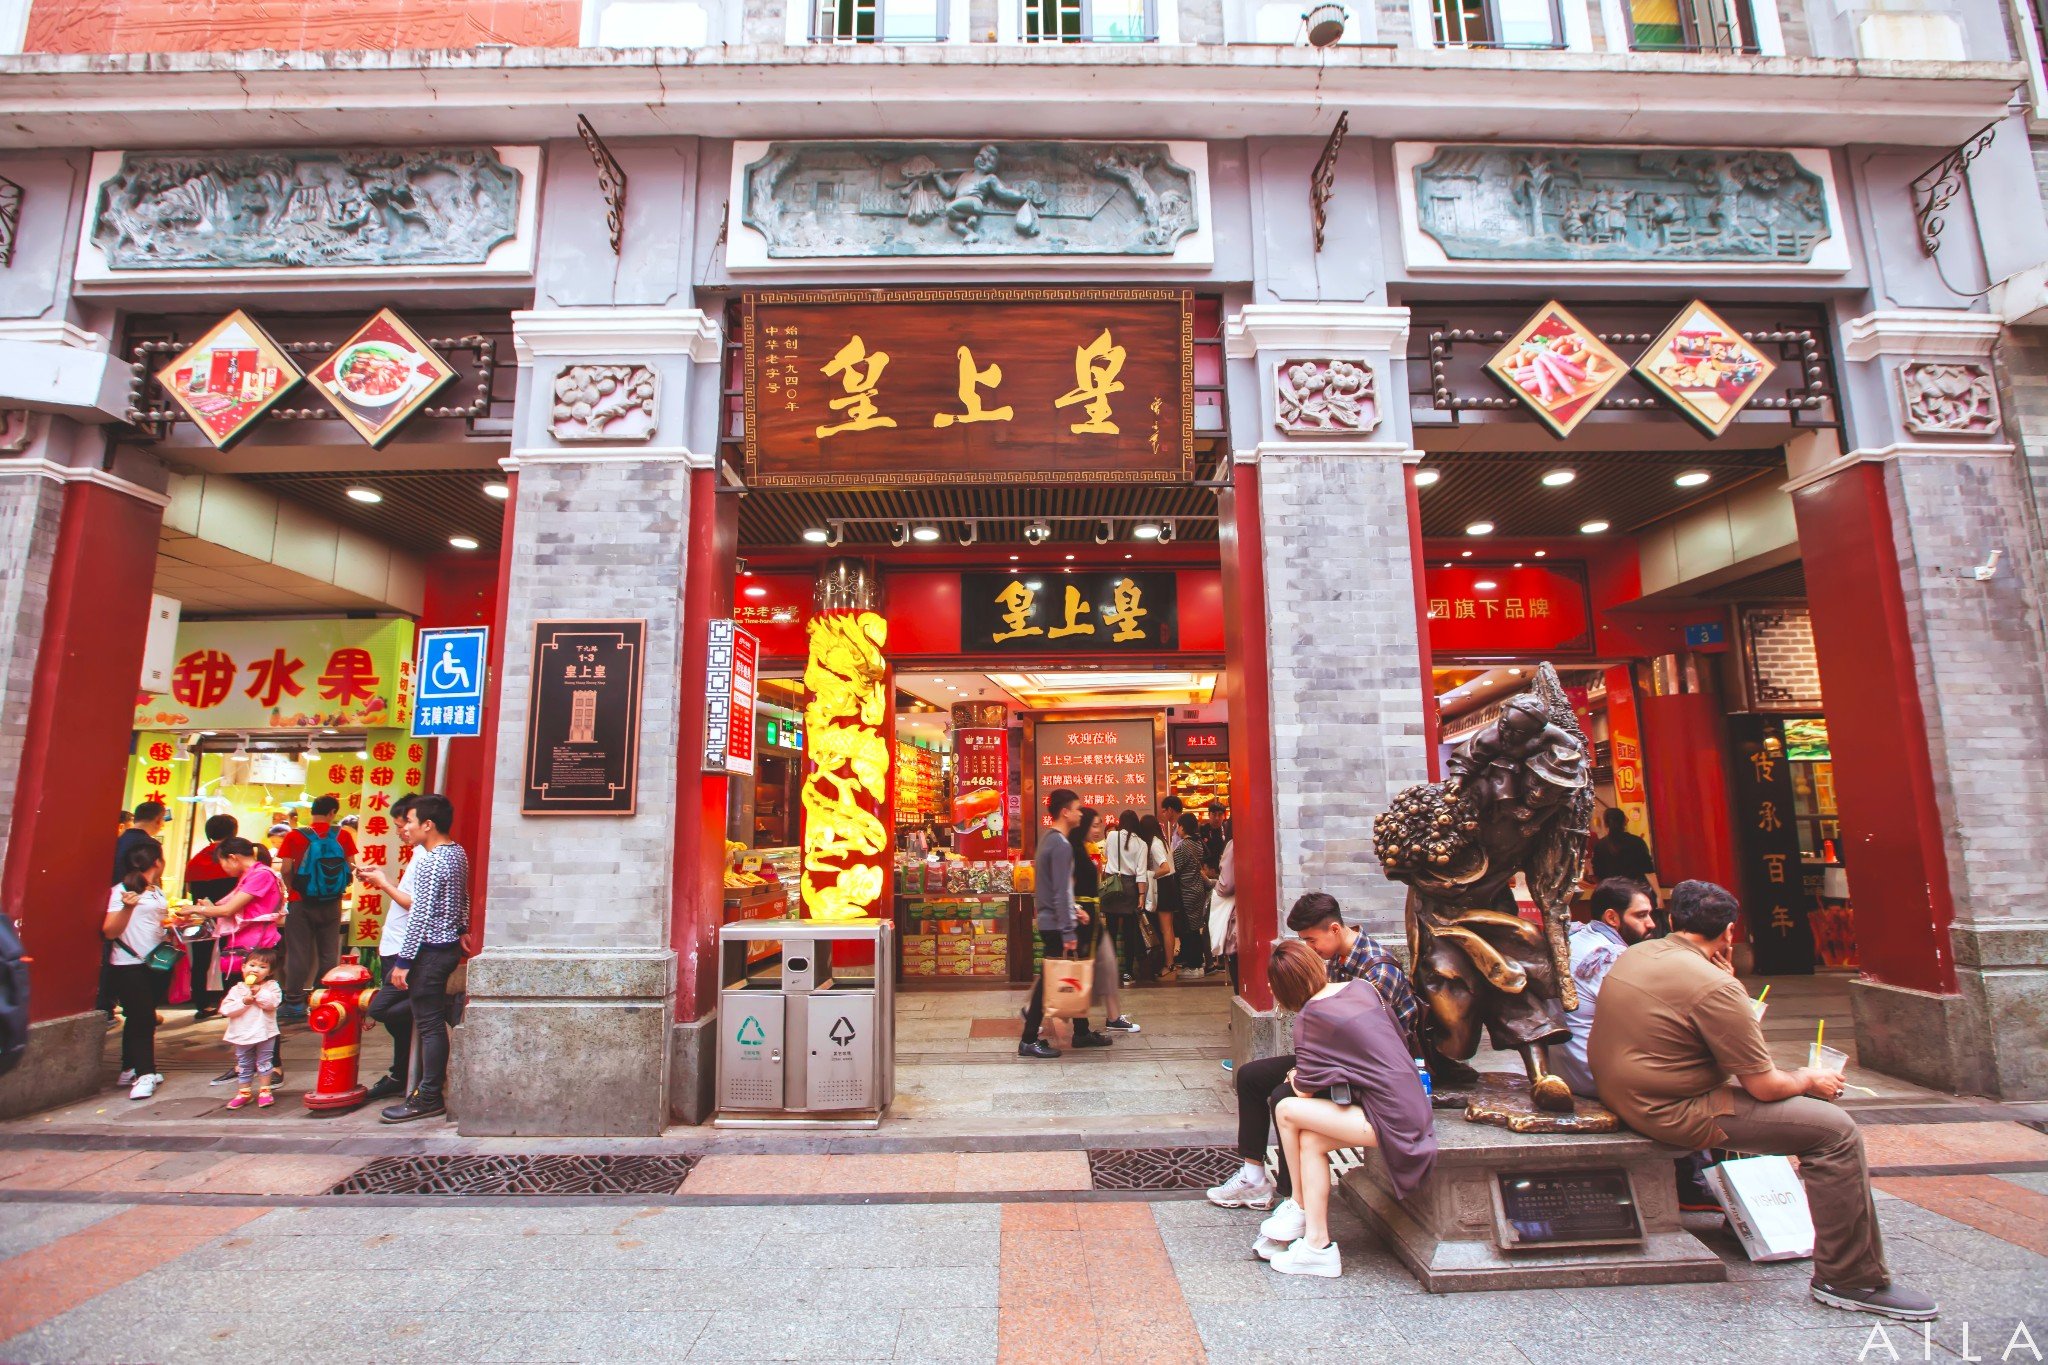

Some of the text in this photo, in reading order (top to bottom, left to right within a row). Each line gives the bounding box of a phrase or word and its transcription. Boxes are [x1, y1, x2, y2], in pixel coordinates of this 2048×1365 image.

[765, 325, 781, 394] 中华老字号
[784, 325, 800, 412] 始创一九四〇年
[815, 327, 1127, 439] 皇上皇
[992, 577, 1148, 644] 皇上皇
[1430, 598, 1549, 620] 团旗下品牌
[1701, 631, 1710, 643] 3
[578, 653, 595, 662] 1-3
[171, 647, 381, 709] 甜水果
[564, 664, 607, 678] 皇上皇
[396, 660, 410, 724] 现切现卖
[420, 704, 476, 726] 无障碍通道
[1067, 731, 1118, 745] 欢迎莅临
[1042, 753, 1146, 766] 皇上皇二楼餐饮体验店
[1617, 766, 1635, 791] 19
[1751, 752, 1795, 937] 传承百年
